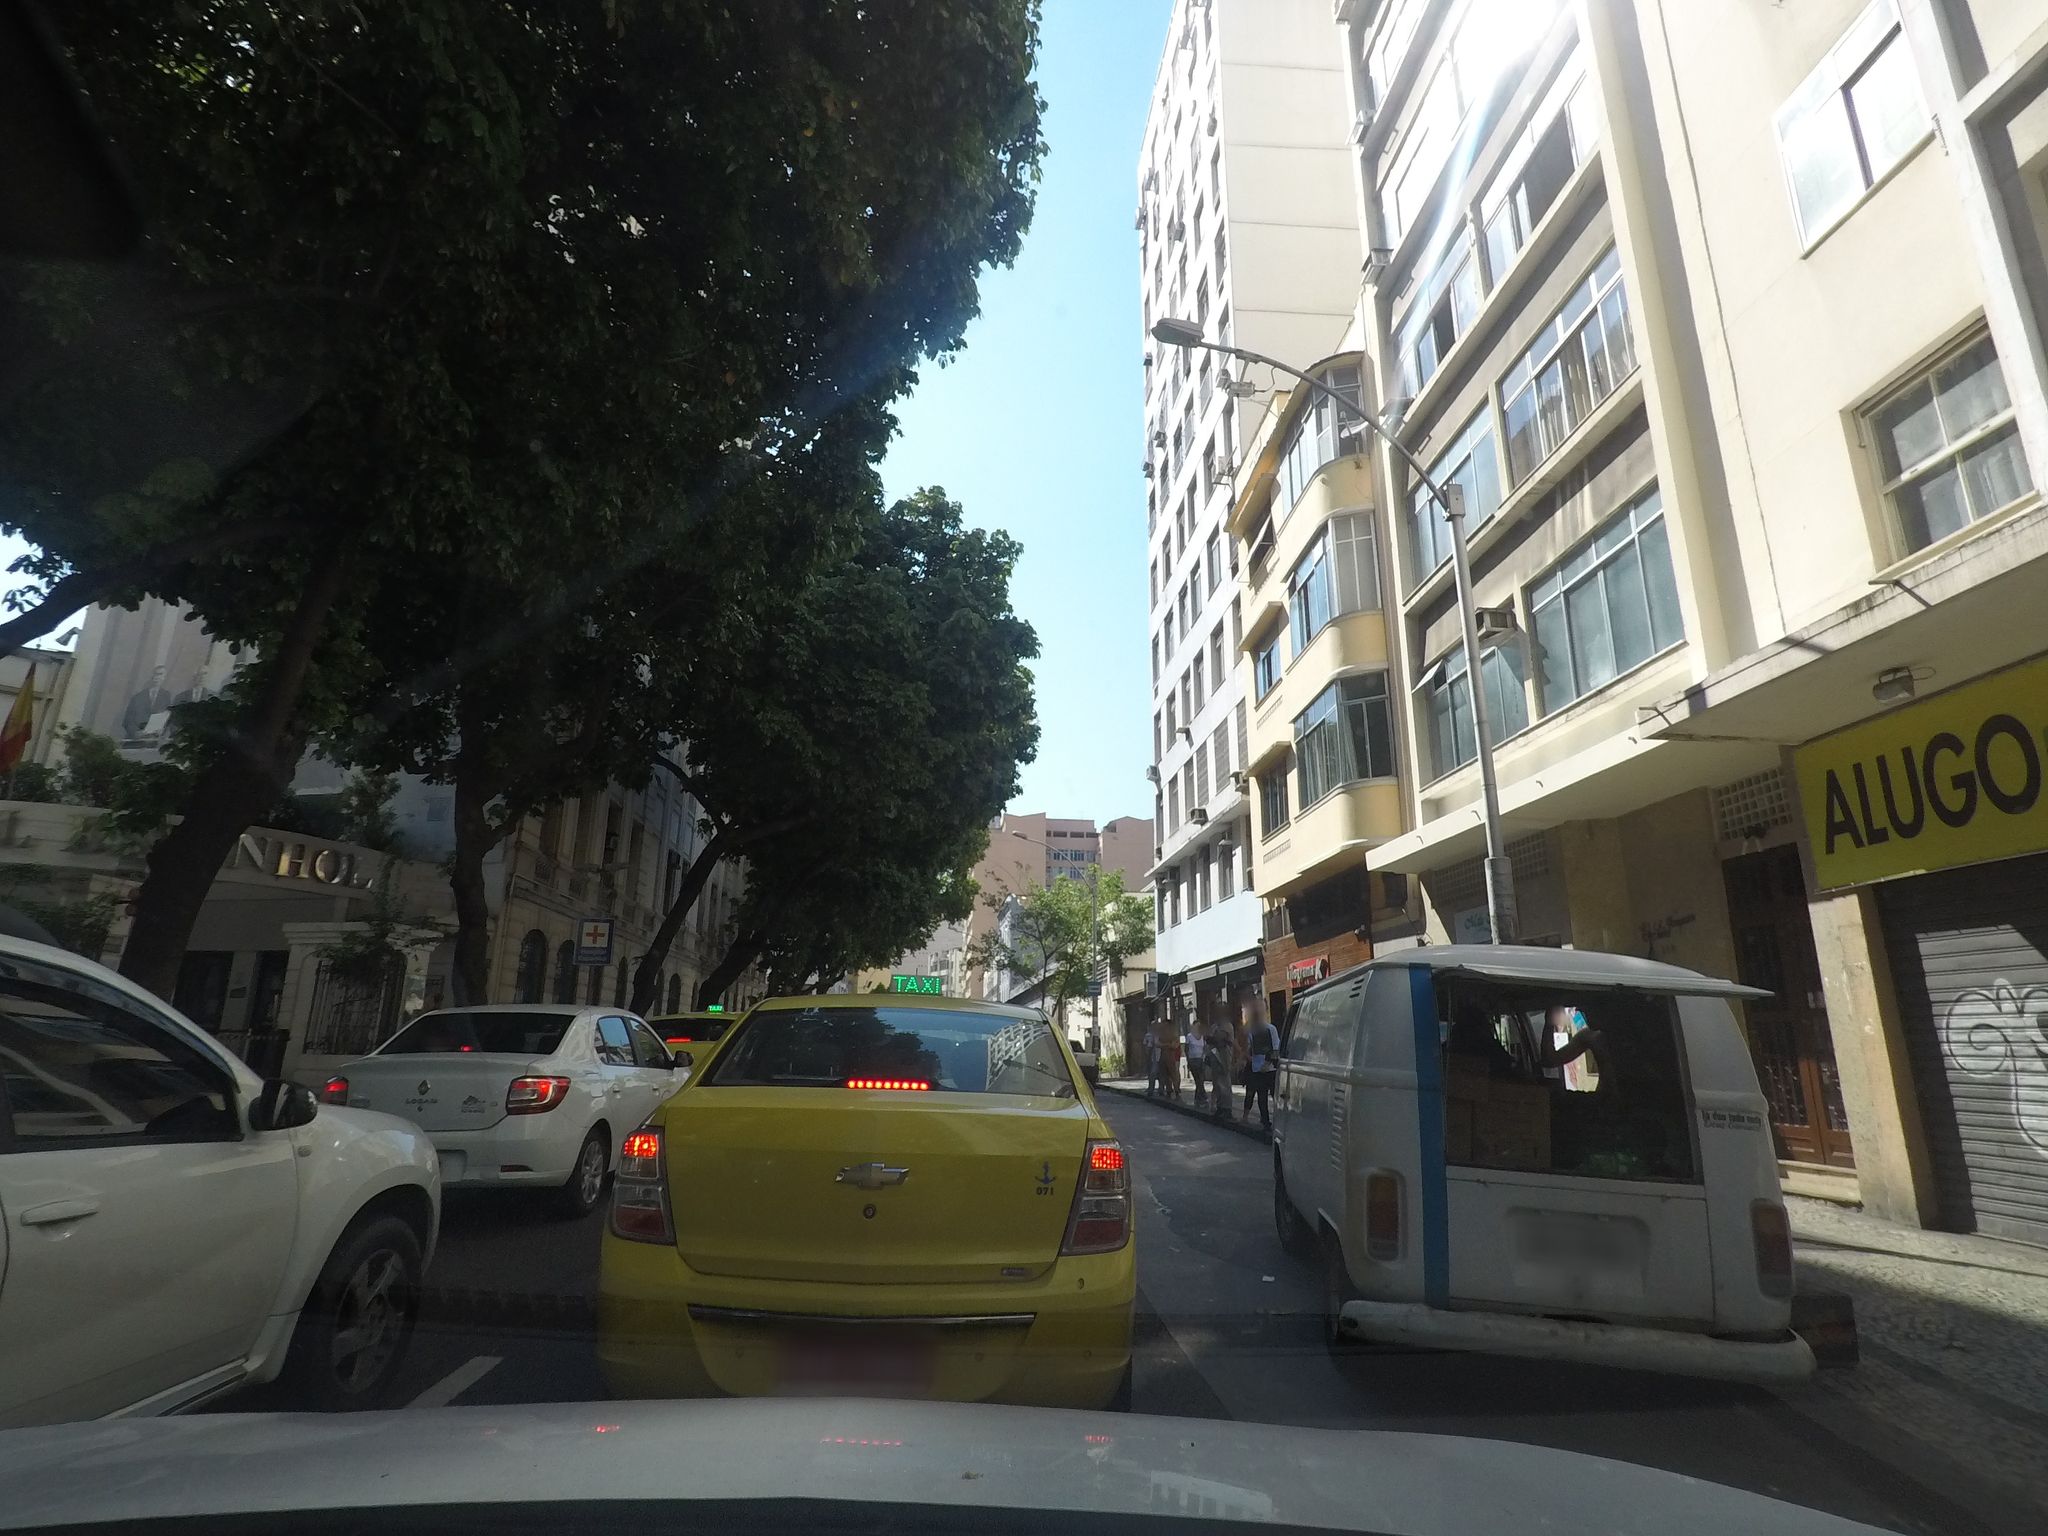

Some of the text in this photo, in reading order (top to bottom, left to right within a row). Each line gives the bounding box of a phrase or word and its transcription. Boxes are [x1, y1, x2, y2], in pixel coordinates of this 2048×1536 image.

[1825, 714, 2042, 855] ALUGO
[228, 833, 374, 889] NHOL
[893, 976, 940, 993] TAXI
[1036, 1186, 1054, 1196] 071
